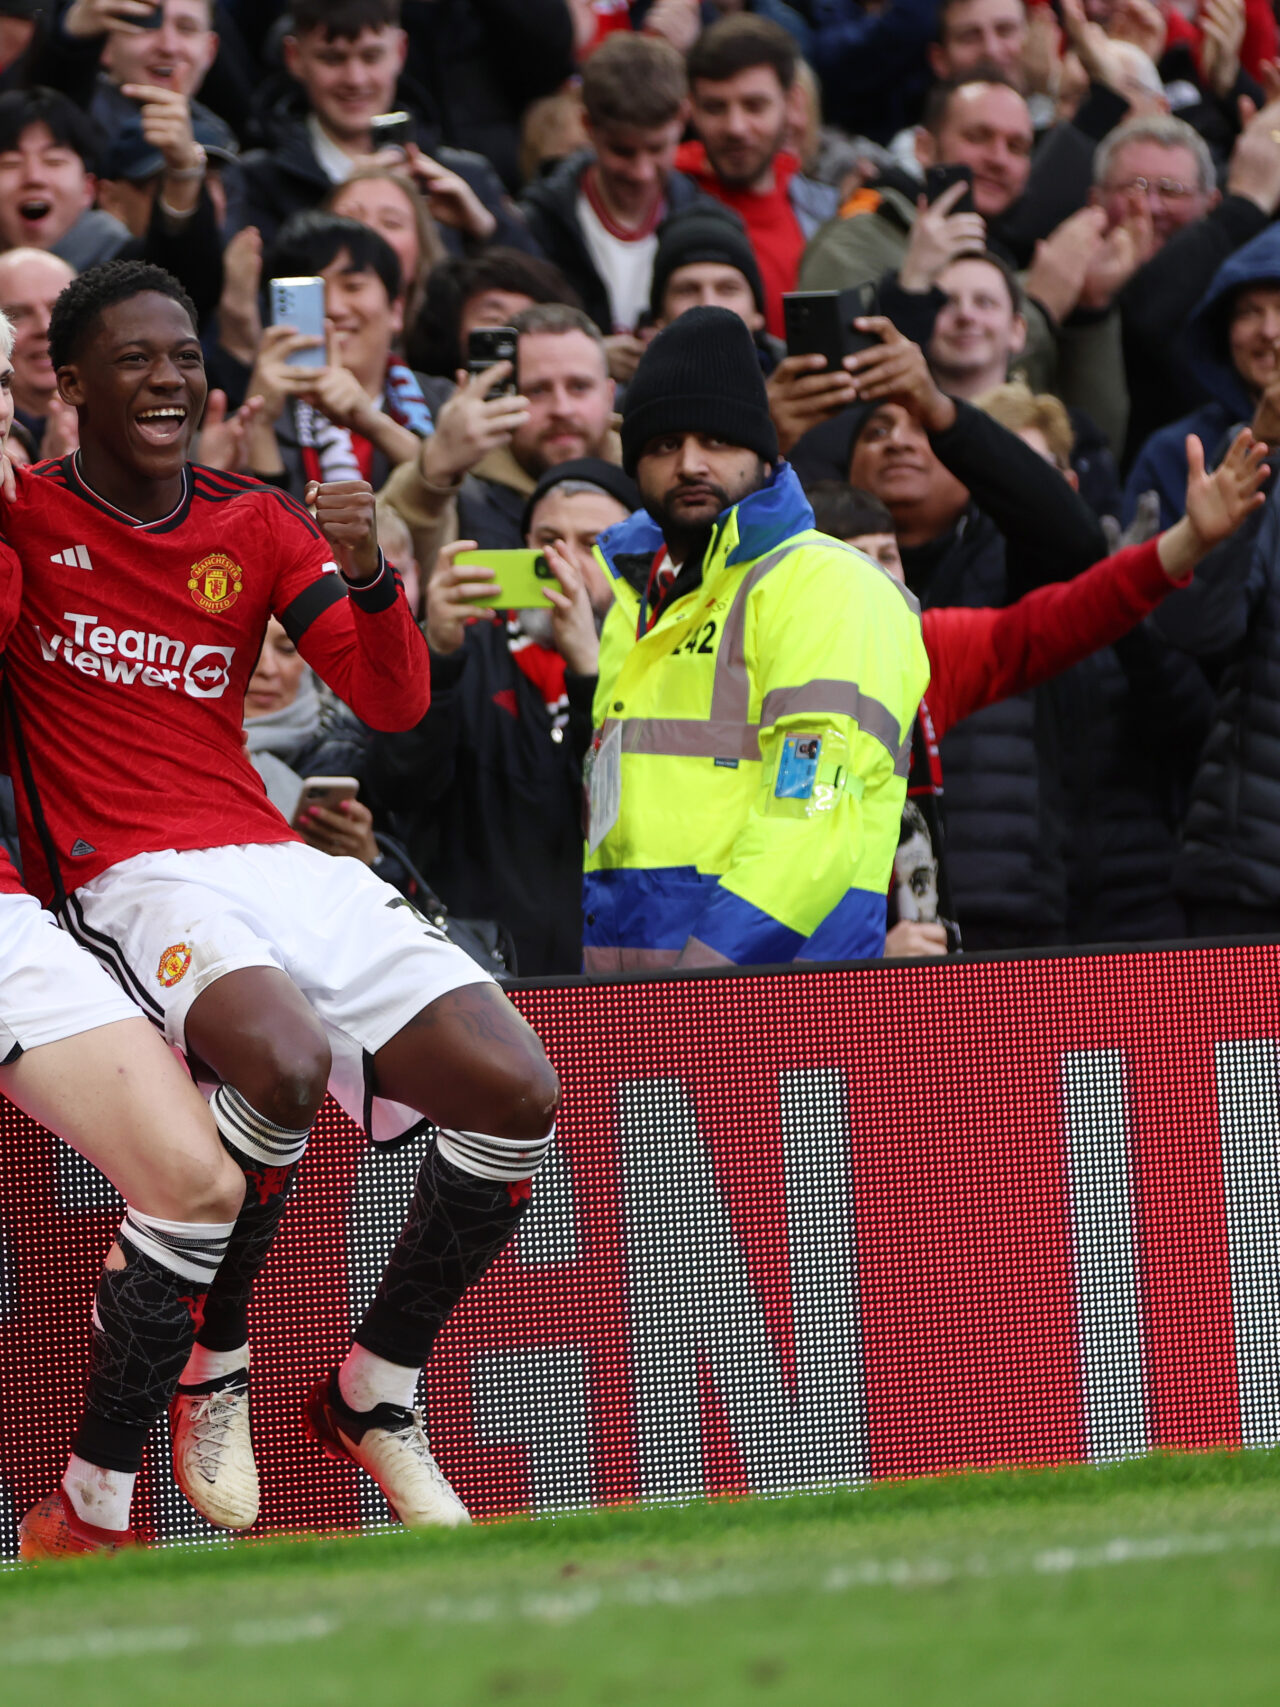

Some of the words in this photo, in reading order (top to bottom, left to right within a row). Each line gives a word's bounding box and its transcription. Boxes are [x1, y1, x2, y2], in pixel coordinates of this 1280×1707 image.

[194, 557, 238, 578] MANCHESTER
[199, 598, 230, 610] UNITED
[33, 625, 181, 691] Viewer
[64, 612, 186, 667] Team
